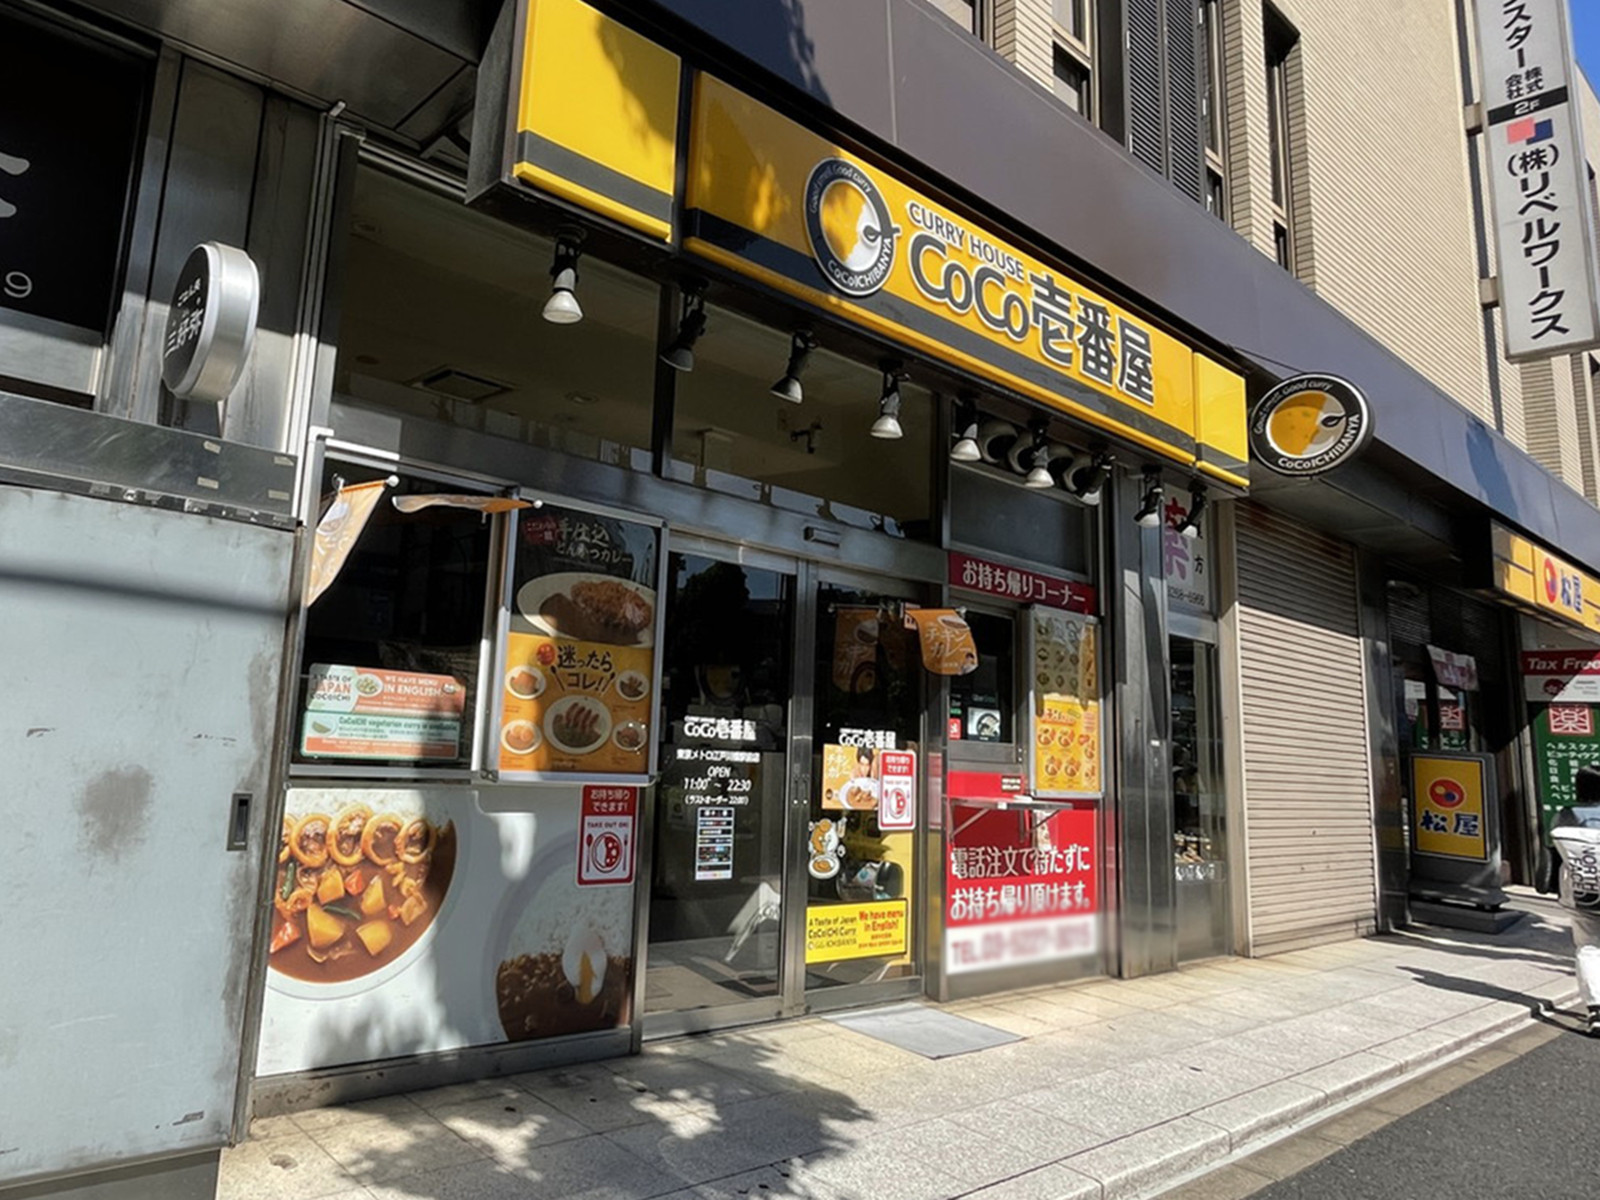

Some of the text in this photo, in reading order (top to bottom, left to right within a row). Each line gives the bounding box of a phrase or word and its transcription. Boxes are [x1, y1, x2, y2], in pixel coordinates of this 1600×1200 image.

[1503, 0, 1532, 68] スター
[907, 201, 1025, 281] CURRY HOUSE
[3, 270, 33, 298] 9
[908, 230, 1154, 407] CoCo壱番屋
[962, 560, 1086, 606] お持ち帰りコーナー
[557, 645, 613, 673] 迷ったら
[1528, 657, 1559, 670] Tax
[1420, 809, 1481, 837] 松屋
